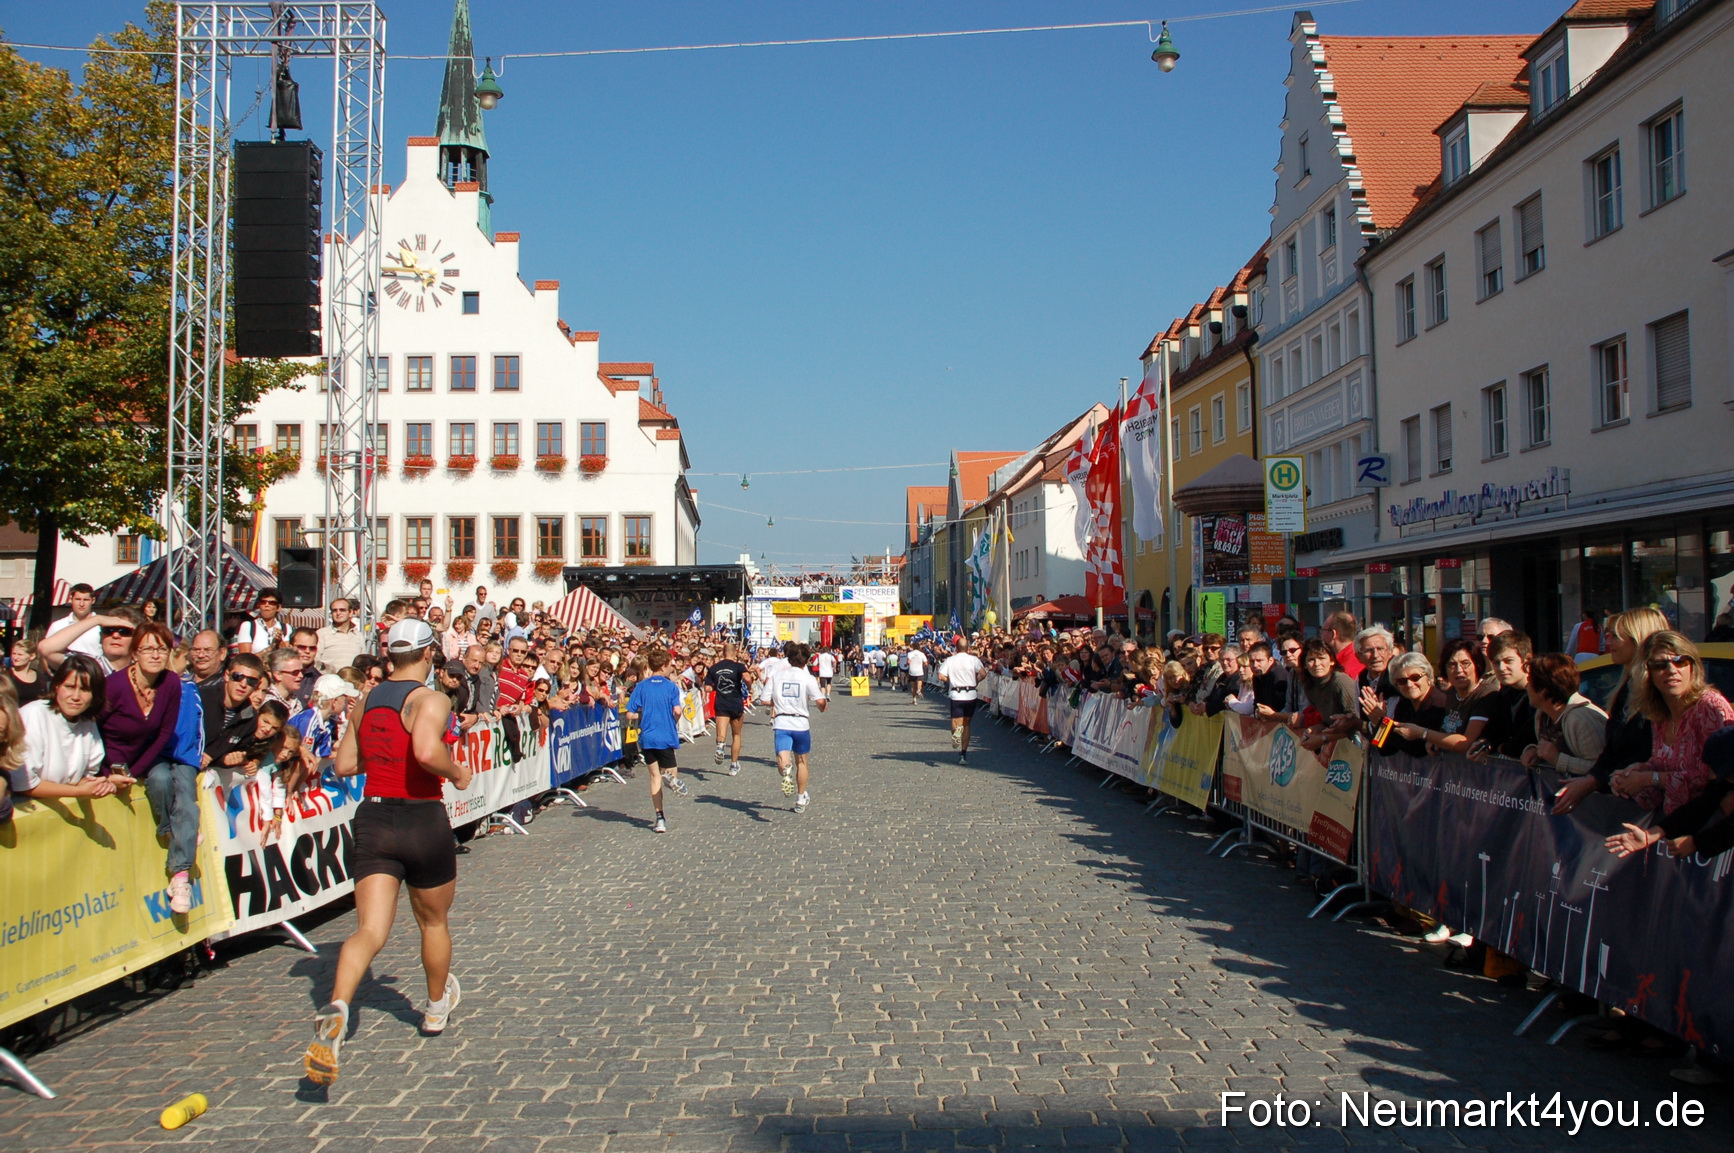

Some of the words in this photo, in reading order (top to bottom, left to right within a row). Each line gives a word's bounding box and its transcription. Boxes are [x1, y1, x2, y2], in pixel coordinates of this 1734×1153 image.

[1277, 467, 1292, 484] H
[1217, 528, 1245, 546] ROCK
[808, 604, 829, 612] ZIEL
[493, 727, 536, 769] Reen
[1328, 763, 1346, 771] vom
[1325, 769, 1351, 784] FASS
[1399, 770, 1411, 784] und
[1412, 771, 1433, 787] Türme
[1444, 779, 1460, 796] sind
[1461, 786, 1488, 802] unsere
[16, 964, 78, 994] Gartenmauern
